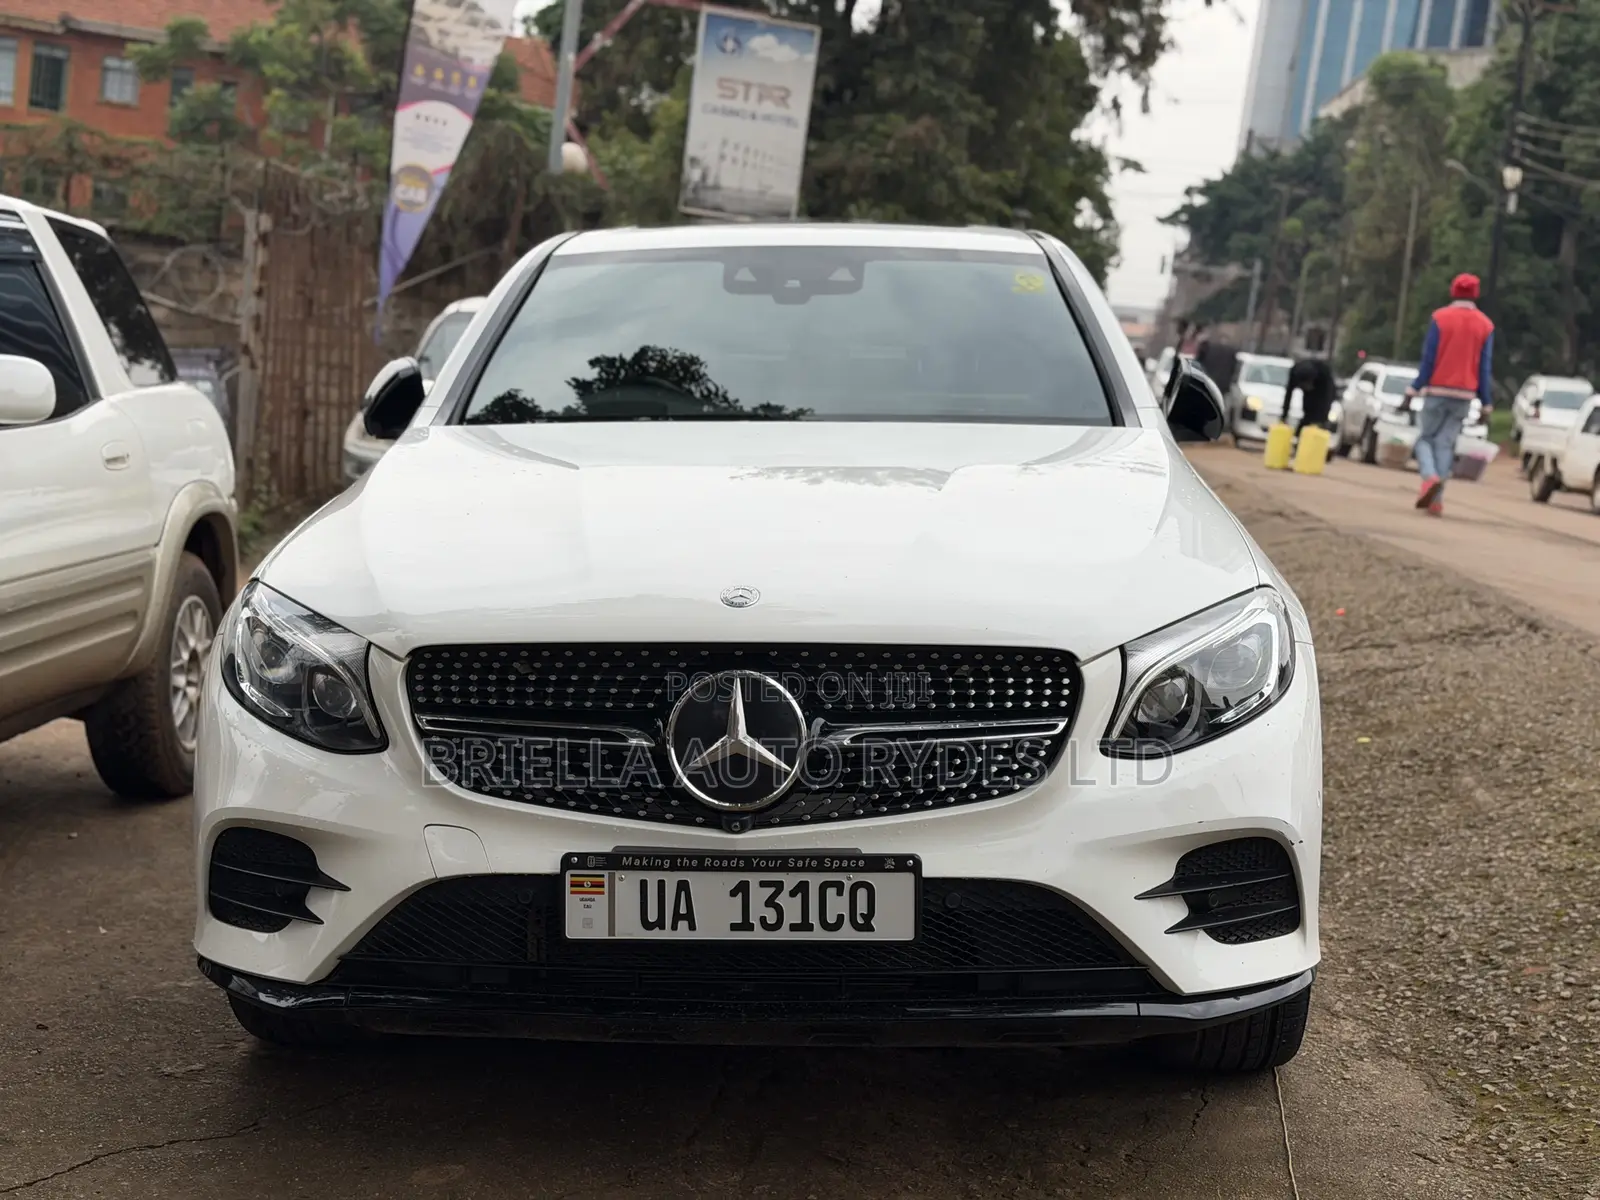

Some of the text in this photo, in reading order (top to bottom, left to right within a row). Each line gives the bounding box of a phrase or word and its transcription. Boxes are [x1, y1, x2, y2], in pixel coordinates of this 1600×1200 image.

[621, 856, 866, 869] Making the Roads Your Safe Space
[639, 879, 877, 933] UA 131CQ
